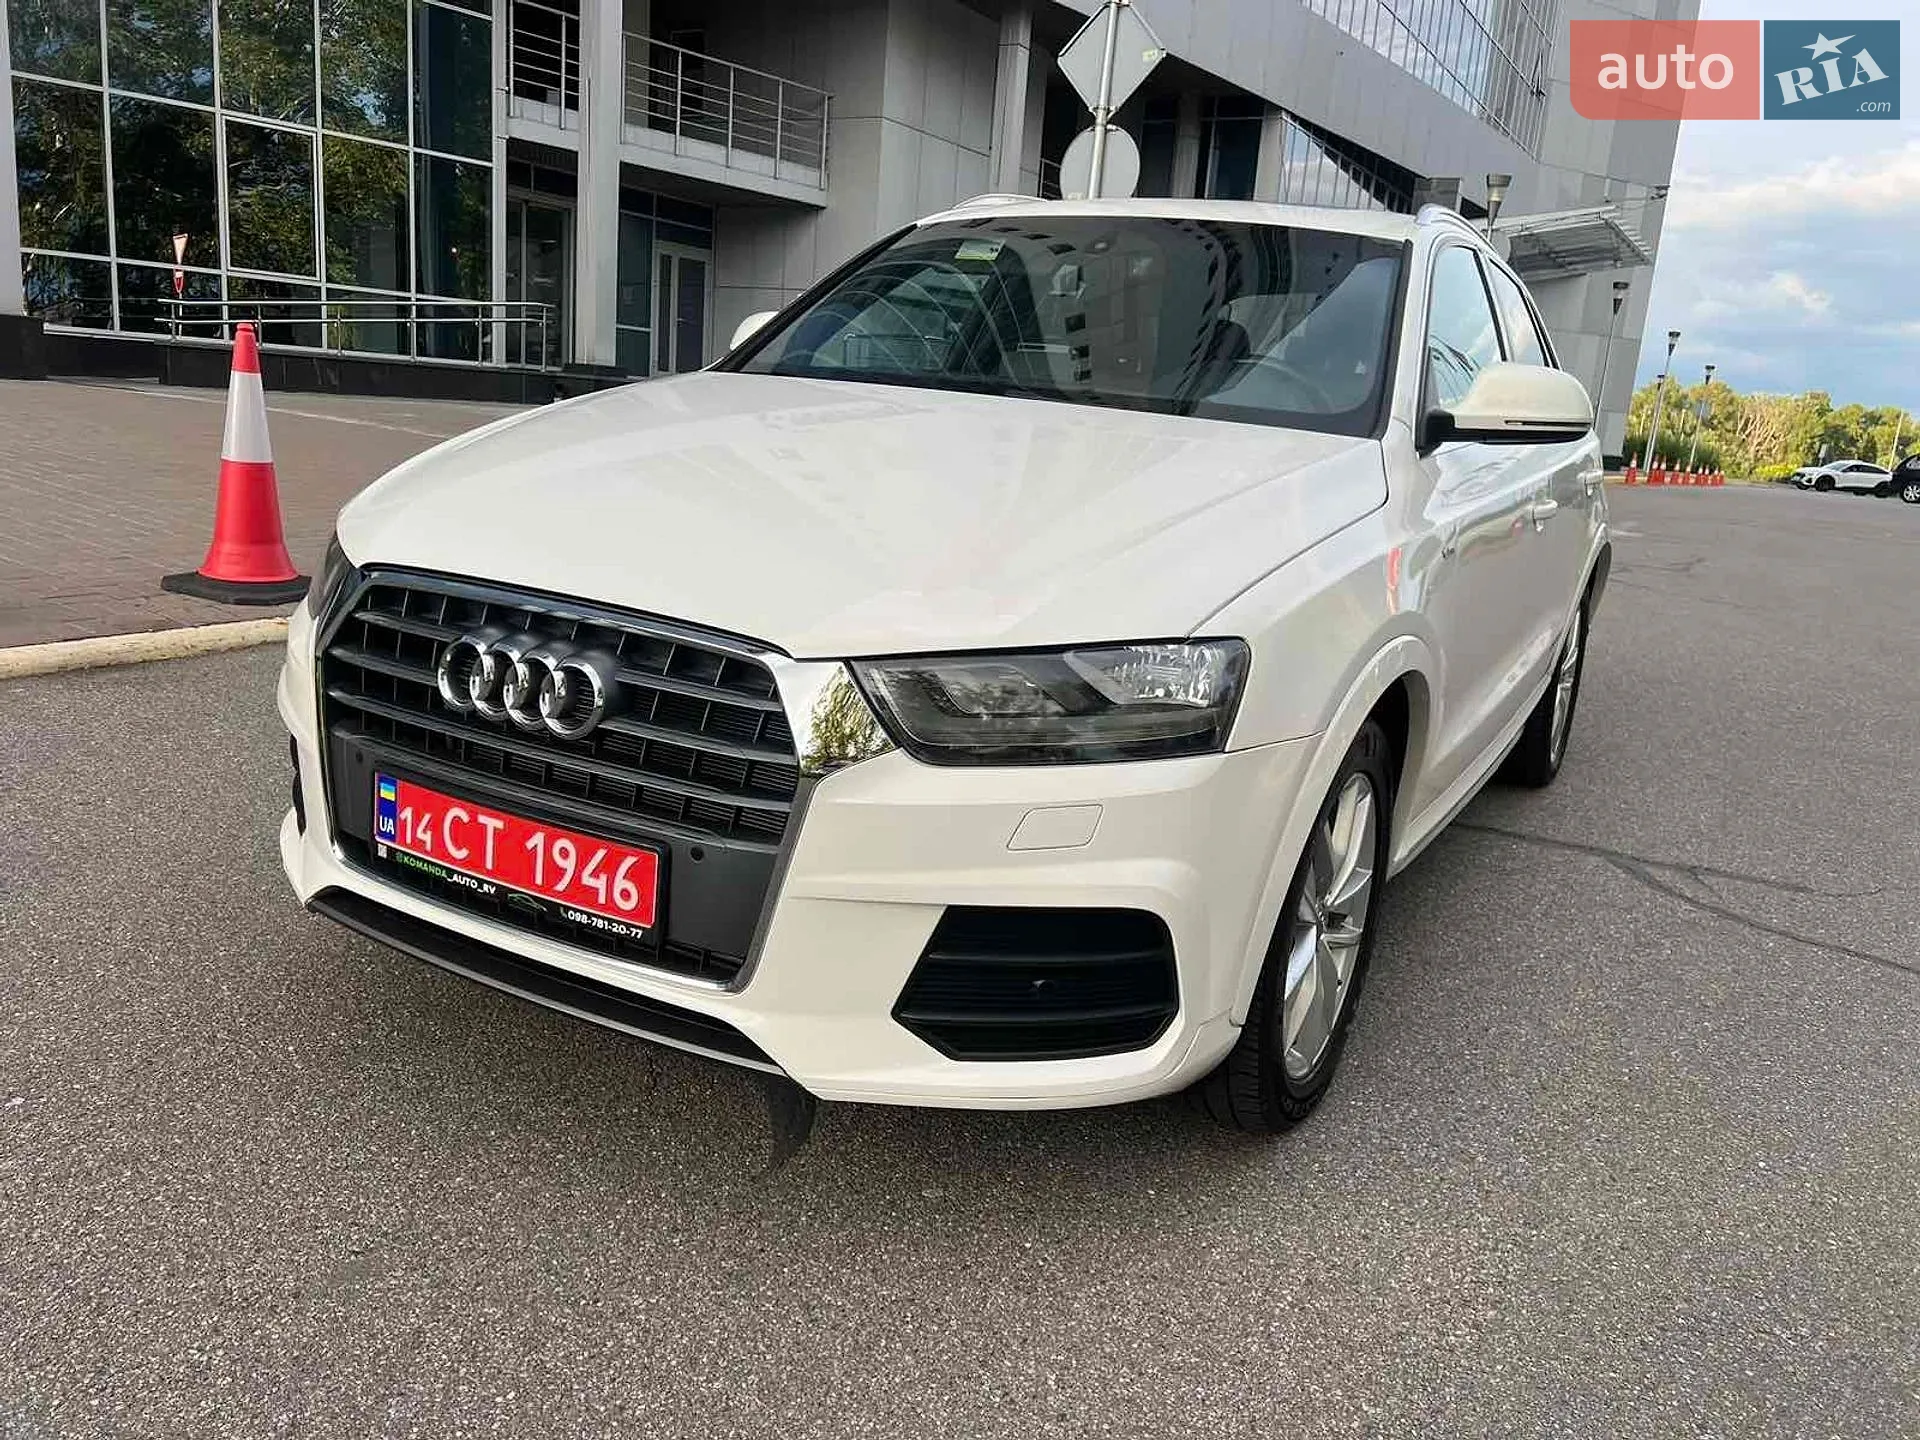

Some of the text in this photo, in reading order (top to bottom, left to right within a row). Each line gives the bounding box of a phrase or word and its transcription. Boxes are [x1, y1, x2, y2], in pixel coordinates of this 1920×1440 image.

[379, 817, 395, 834] UA
[399, 806, 640, 911] 14 CT 1946
